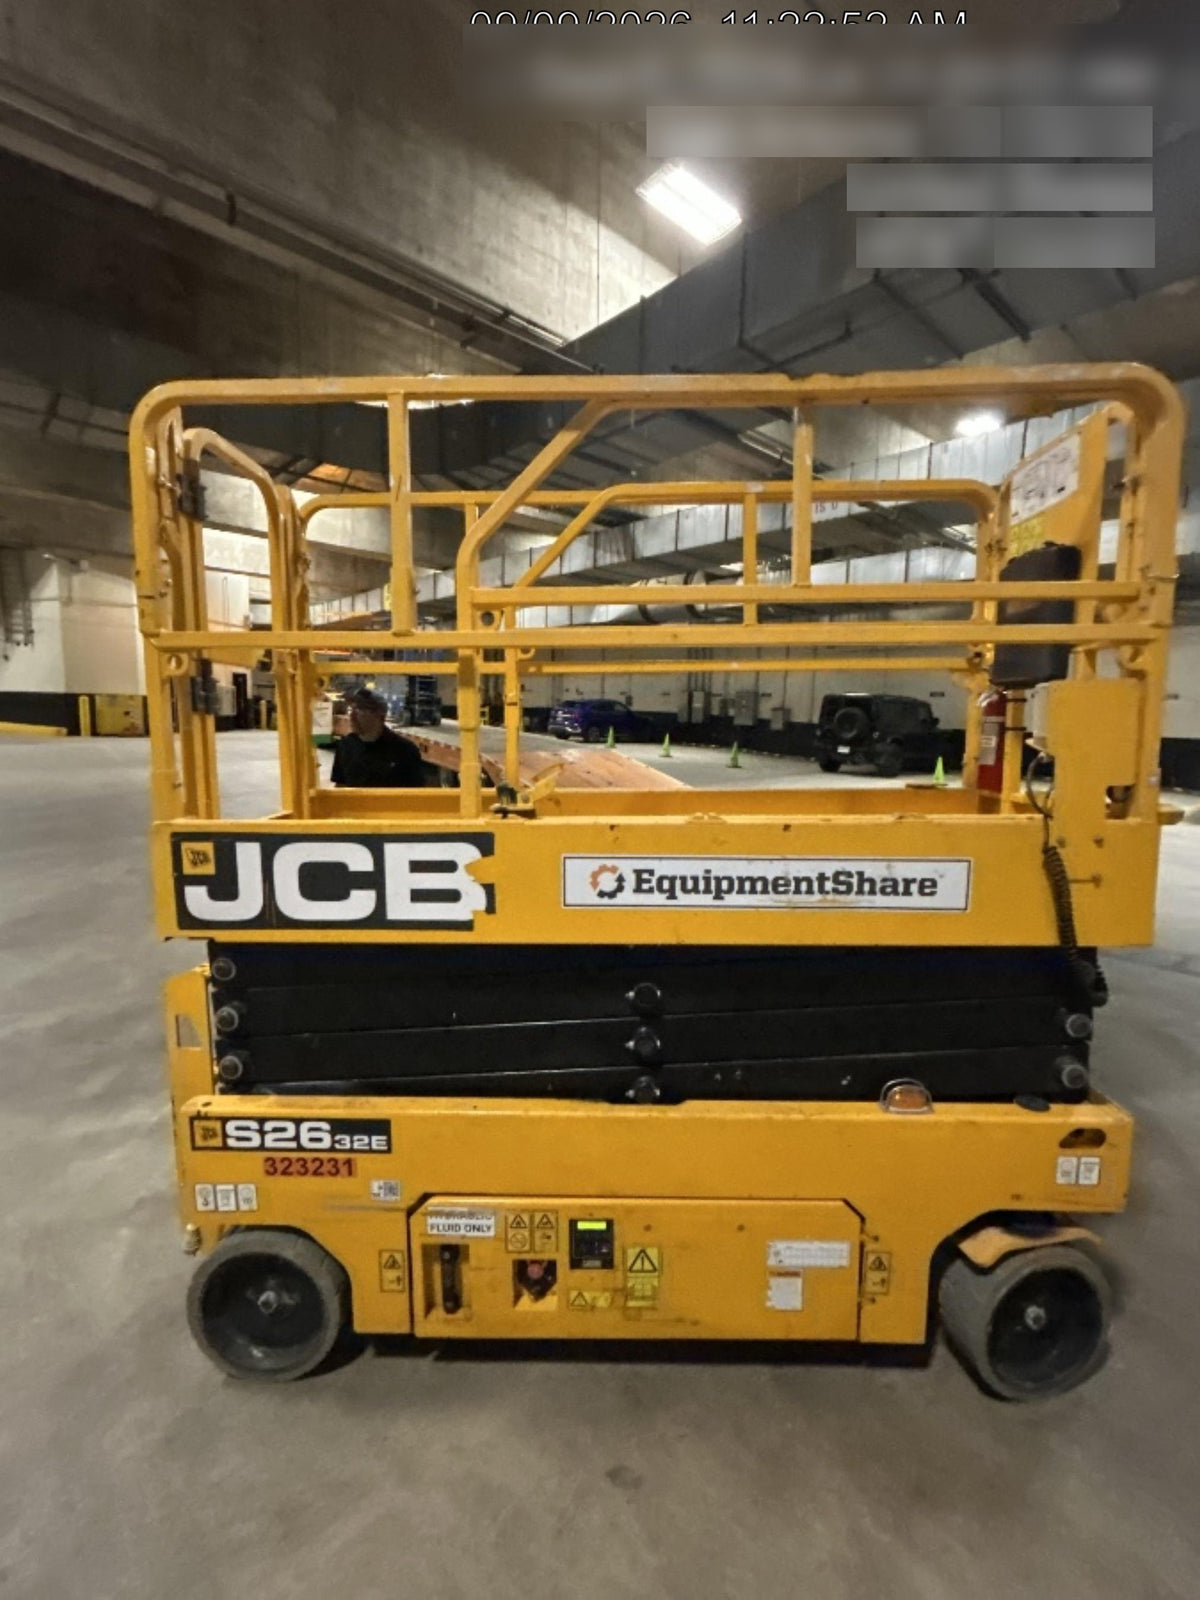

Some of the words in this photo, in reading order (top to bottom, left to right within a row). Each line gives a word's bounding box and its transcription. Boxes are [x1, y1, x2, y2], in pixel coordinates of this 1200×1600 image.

[184, 841, 488, 922] JCB
[632, 867, 938, 900] EquipmentShare
[224, 1118, 333, 1149] S26
[333, 1134, 389, 1151] 32E
[264, 1156, 354, 1177] 323231
[429, 1223, 462, 1233] FLUID
[463, 1223, 492, 1233] ONLY
